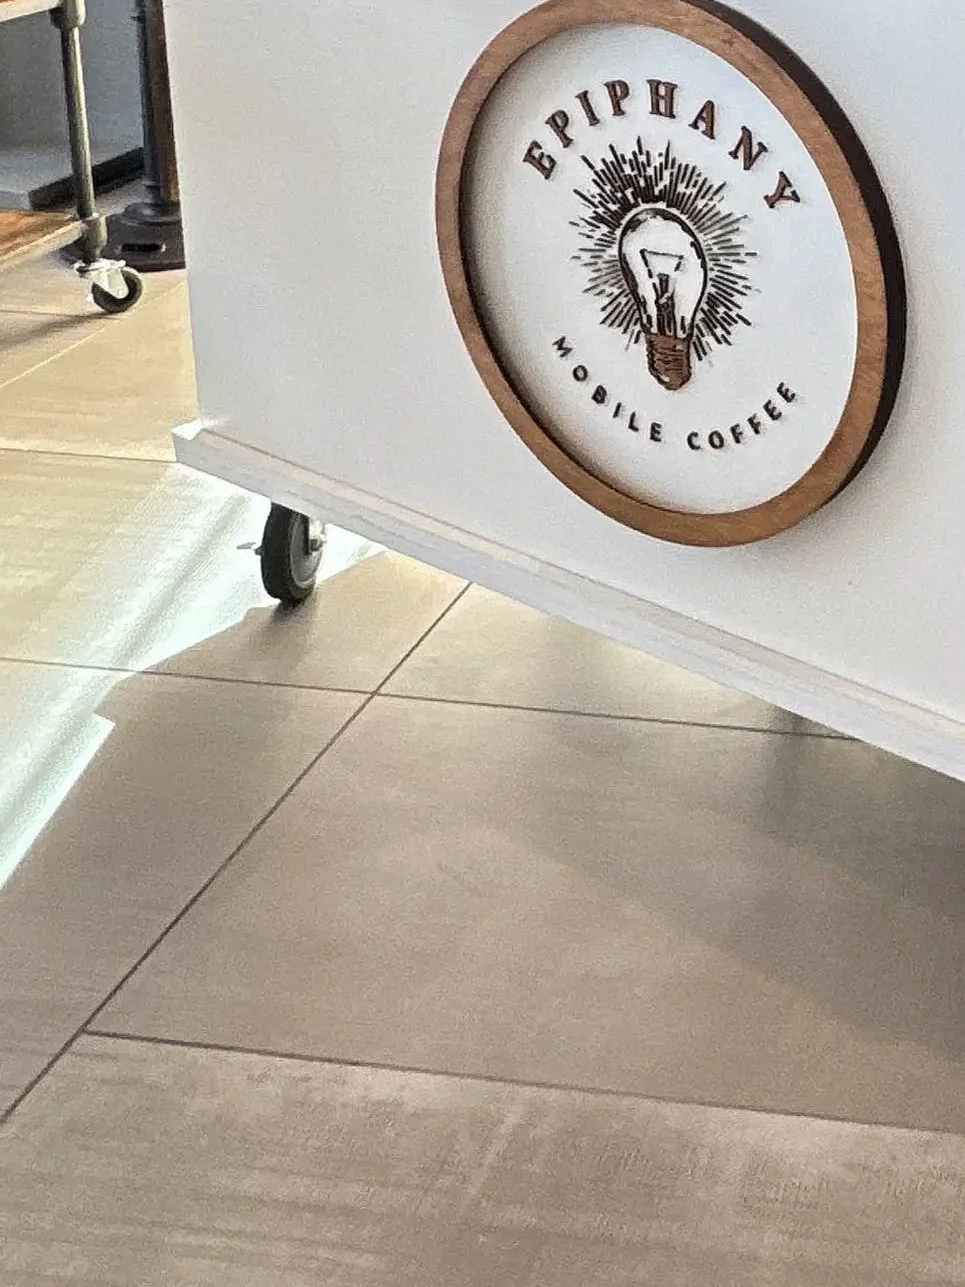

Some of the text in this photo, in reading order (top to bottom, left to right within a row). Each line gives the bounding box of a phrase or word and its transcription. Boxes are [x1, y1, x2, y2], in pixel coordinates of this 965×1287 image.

[522, 78, 801, 209] EPIPHANY
[551, 335, 796, 451] MOBILE COFFEE
